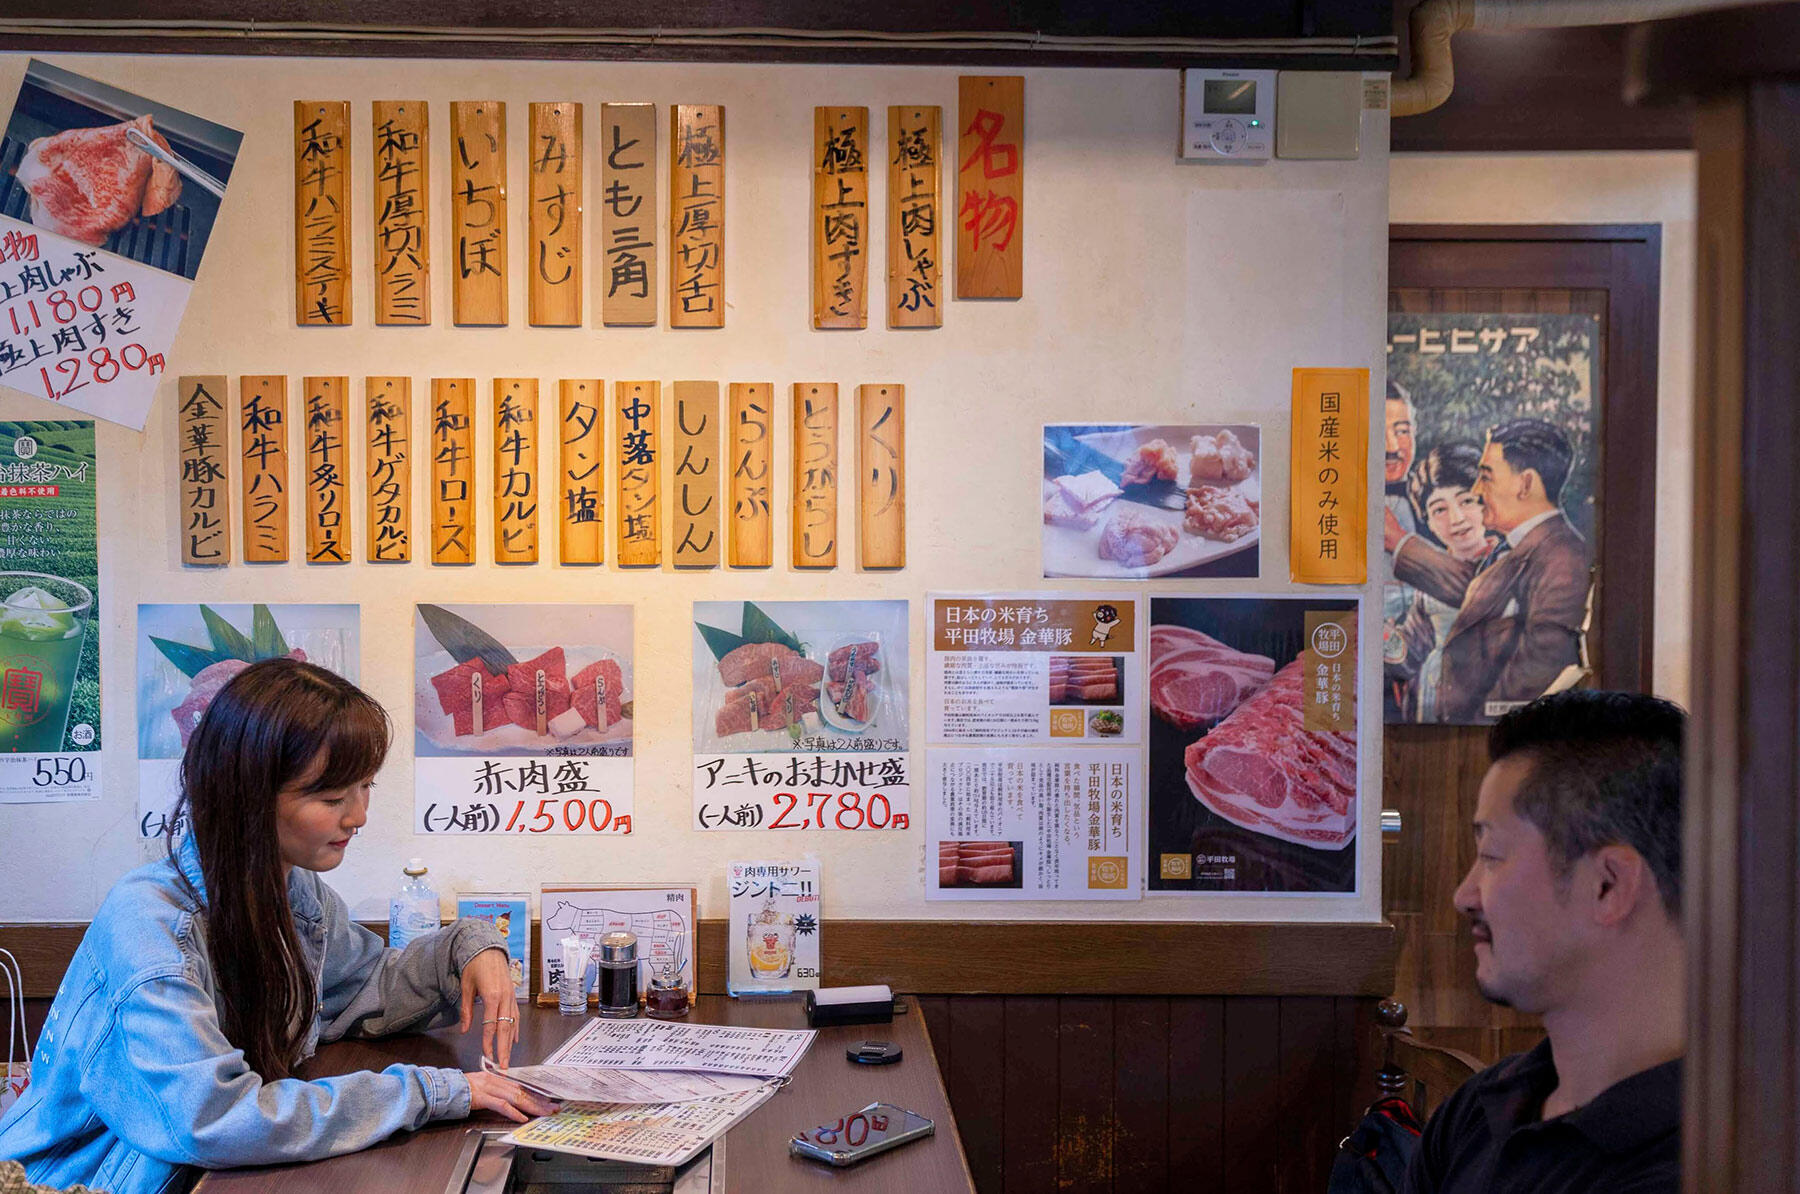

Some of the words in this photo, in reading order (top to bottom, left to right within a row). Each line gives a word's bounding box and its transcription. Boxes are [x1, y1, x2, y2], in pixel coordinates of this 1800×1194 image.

[0, 230, 39, 264] 物
[377, 119, 423, 320] 和牛厚切ハラミ
[457, 133, 501, 279] いちぼ
[533, 135, 575, 285] みすじ
[605, 125, 654, 298] とも三角
[677, 124, 722, 313] 極上厚切舌
[820, 126, 864, 316] 極上肉すき
[893, 126, 935, 312] 極上肉しゃぶ
[958, 108, 1018, 252] 名物
[9, 281, 136, 336] 1,180円
[40, 343, 166, 400] 1,280円
[179, 383, 226, 559] 金華豚カルビ
[242, 395, 283, 553] 和牛ハラミ
[308, 395, 344, 561] 和牛炙りロース
[369, 393, 408, 561] 和牛ゲタカルビ
[434, 400, 470, 556] 和牛ロース
[498, 395, 537, 554] 和牛カルビ
[563, 401, 603, 525] タン塩
[621, 397, 657, 544] 中落タン塩
[676, 400, 714, 554] しんしん
[869, 406, 897, 517] くり
[1318, 392, 1340, 560] 国産米のみ使用
[944, 628, 1015, 646] 平田牧場
[1020, 628, 1073, 646] 金華豚
[946, 606, 1049, 625] 日本の米育ち
[73, 728, 92, 739] お酒
[473, 761, 601, 796] 赤肉盛
[697, 756, 910, 789] アニキのおまかせ盛
[1110, 763, 1123, 838] 日本の米育ち
[423, 803, 501, 833] (一人前)
[505, 799, 632, 835] 1,500円
[698, 803, 764, 829] (一人前)
[768, 791, 909, 831] 2,780円
[744, 866, 811, 877] 肉専用サワー
[1088, 763, 1100, 851] 平田牧場金華豚
